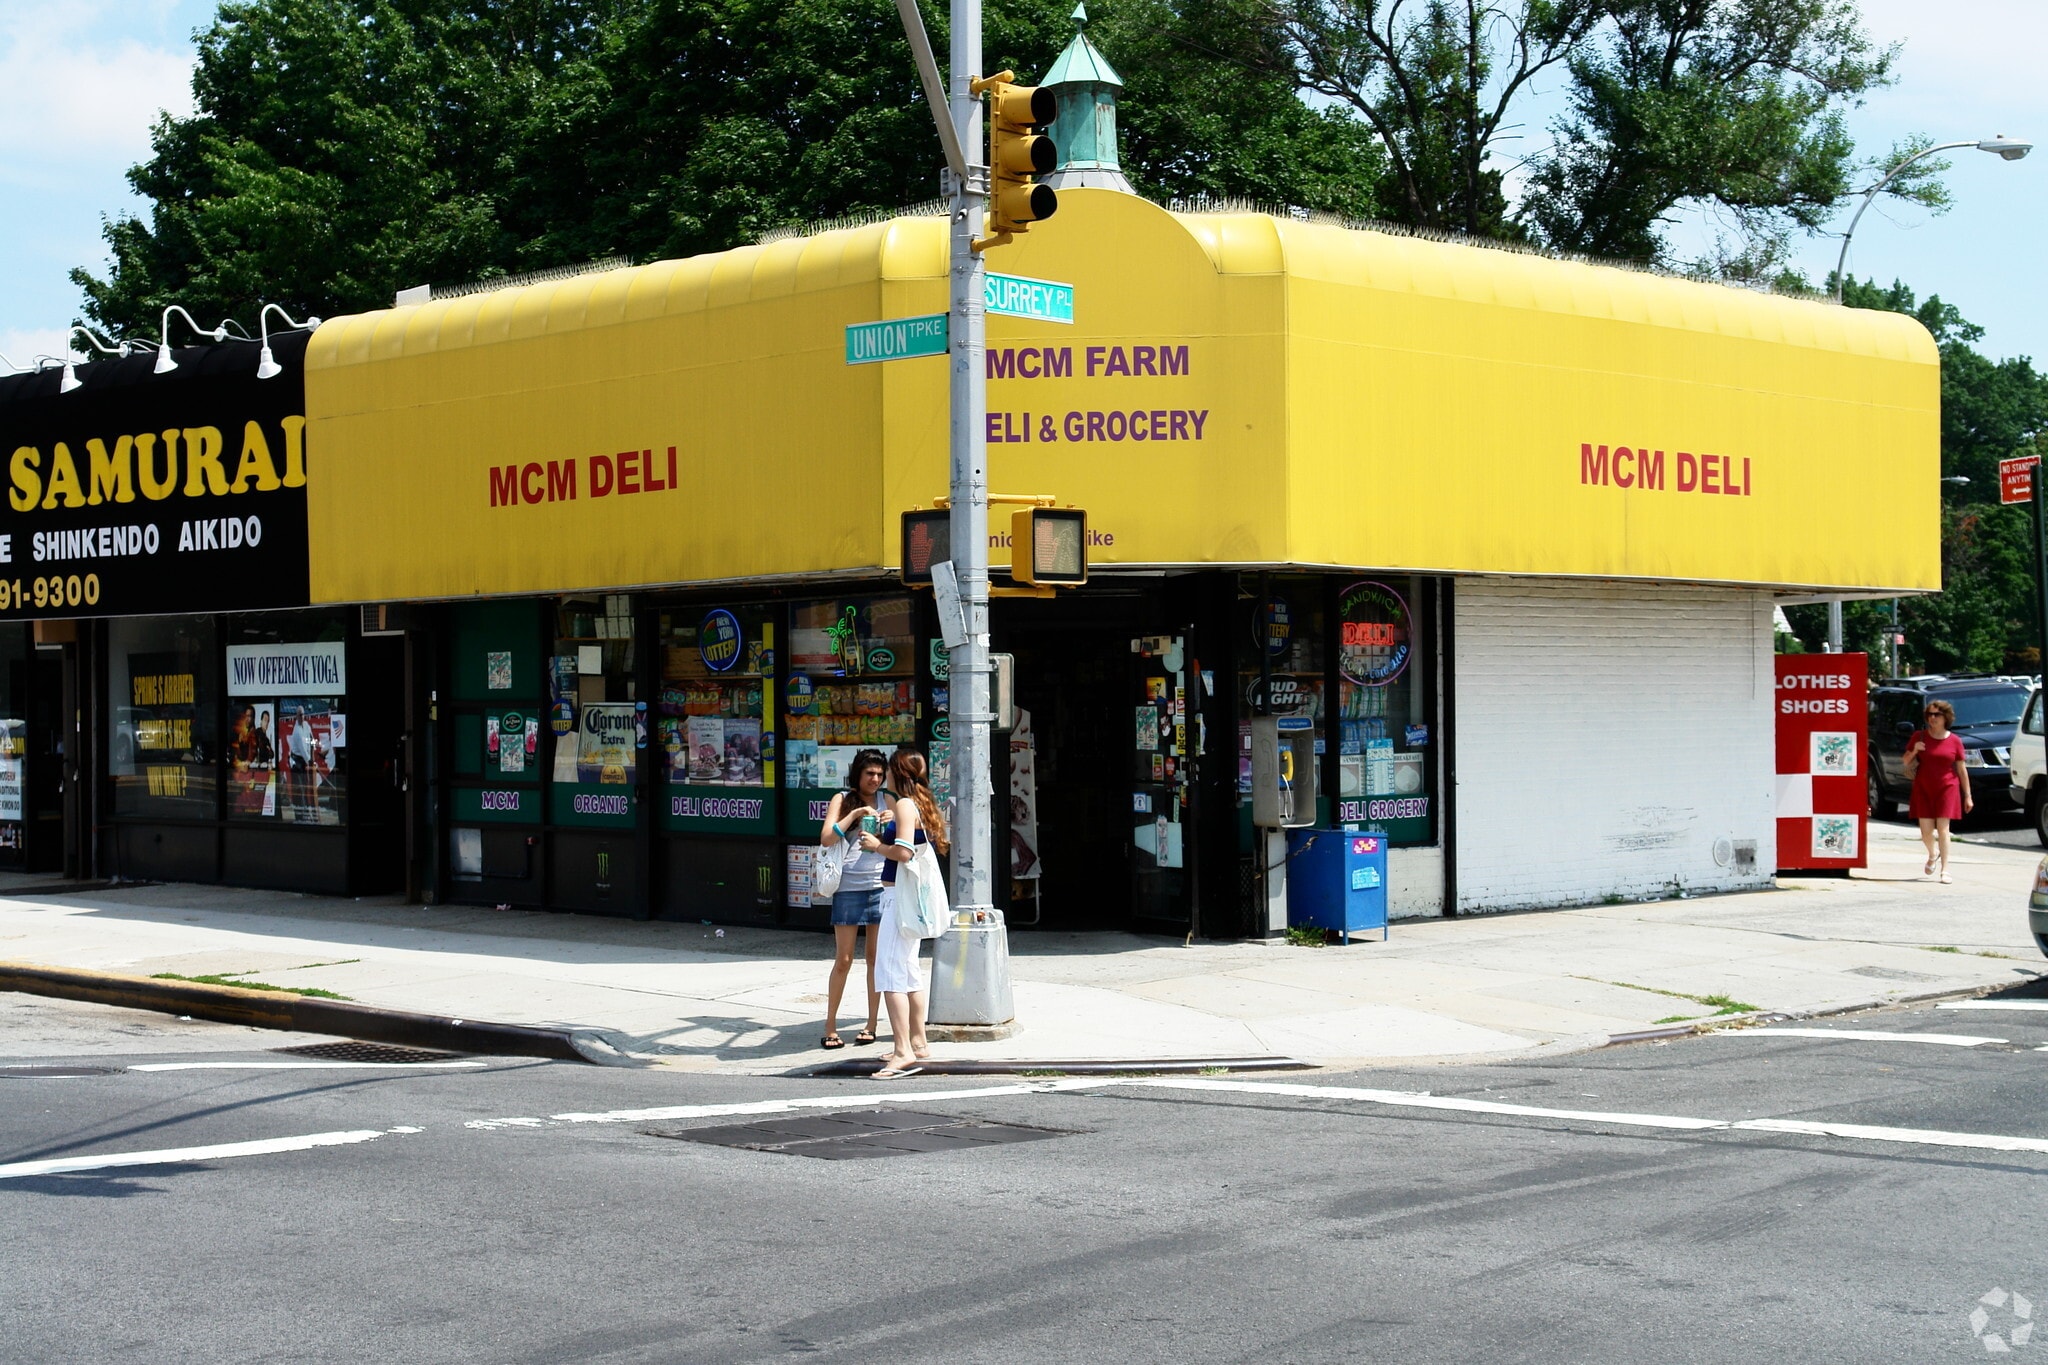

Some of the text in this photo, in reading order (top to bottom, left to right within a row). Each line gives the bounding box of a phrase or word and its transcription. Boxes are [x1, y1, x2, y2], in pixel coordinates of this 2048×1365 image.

[985, 276, 1071, 316] SURREY PL
[854, 321, 942, 359] UNION TPKE
[986, 345, 1190, 379] MCM FARM
[986, 409, 1209, 443] ELI & GROCERY
[9, 415, 307, 512] SAMURAI
[490, 446, 678, 507] MCM DELI
[1581, 443, 1751, 496] MCM DELI
[2002, 464, 2010, 474] NO
[33, 523, 160, 562] SHINKENDO
[178, 515, 262, 552] AIKIDO
[1342, 622, 1396, 646] DELI
[233, 655, 339, 685] NOW OFFERING YOGA
[1781, 699, 1850, 714] SHOES
[174, 718, 192, 749] HERE
[601, 732, 626, 745] Extra
[147, 766, 162, 796] WHY
[482, 791, 519, 810] MCM
[574, 794, 627, 814] ORGANIC
[672, 797, 762, 819] DELI GROCERY
[1340, 797, 1429, 821] DELI GROCERY
